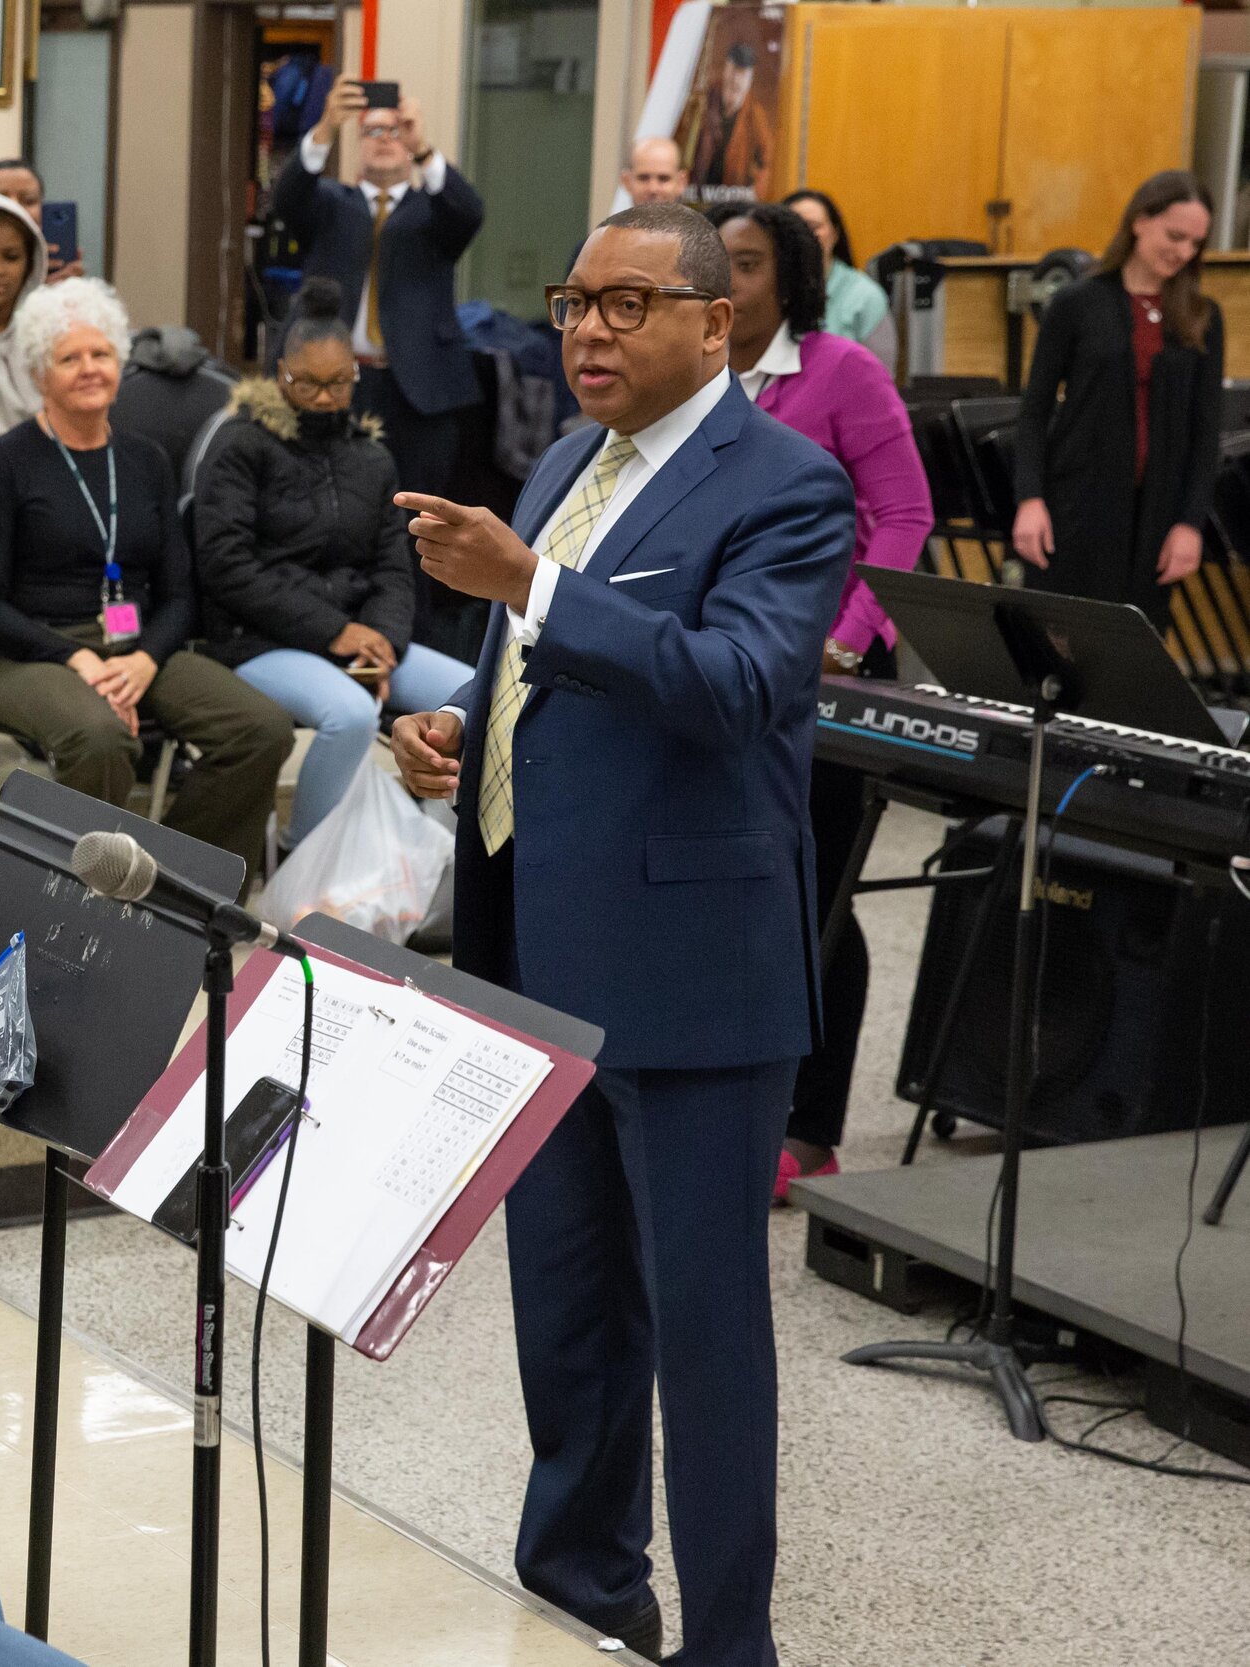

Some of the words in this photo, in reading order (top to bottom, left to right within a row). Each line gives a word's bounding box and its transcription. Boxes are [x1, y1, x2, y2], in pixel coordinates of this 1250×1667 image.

[203, 1304, 216, 1320] On
[201, 1322, 215, 1352] Stage
[201, 1352, 214, 1387] Stands
